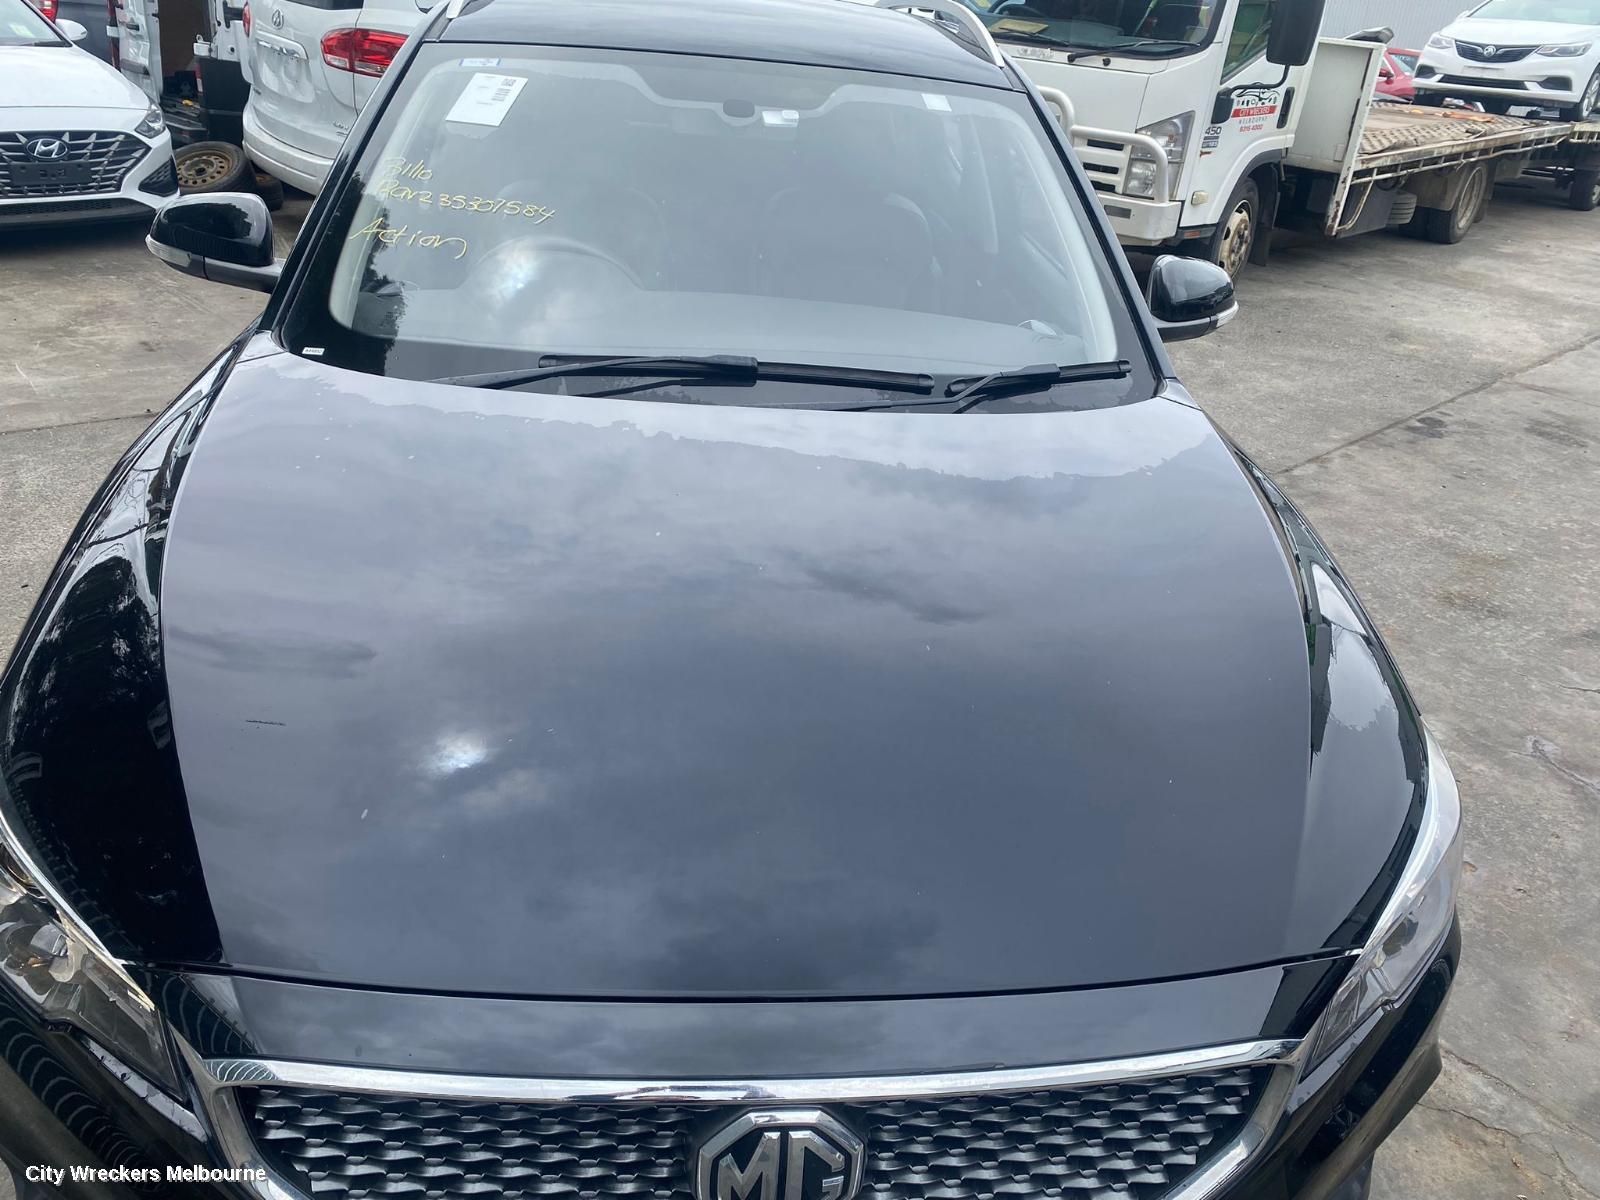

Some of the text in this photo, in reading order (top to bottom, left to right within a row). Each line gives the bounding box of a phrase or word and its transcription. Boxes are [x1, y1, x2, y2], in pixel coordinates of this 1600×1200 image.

[1205, 126, 1222, 135] 450
[350, 217, 467, 260] Action
[717, 1131, 846, 1200] MG
